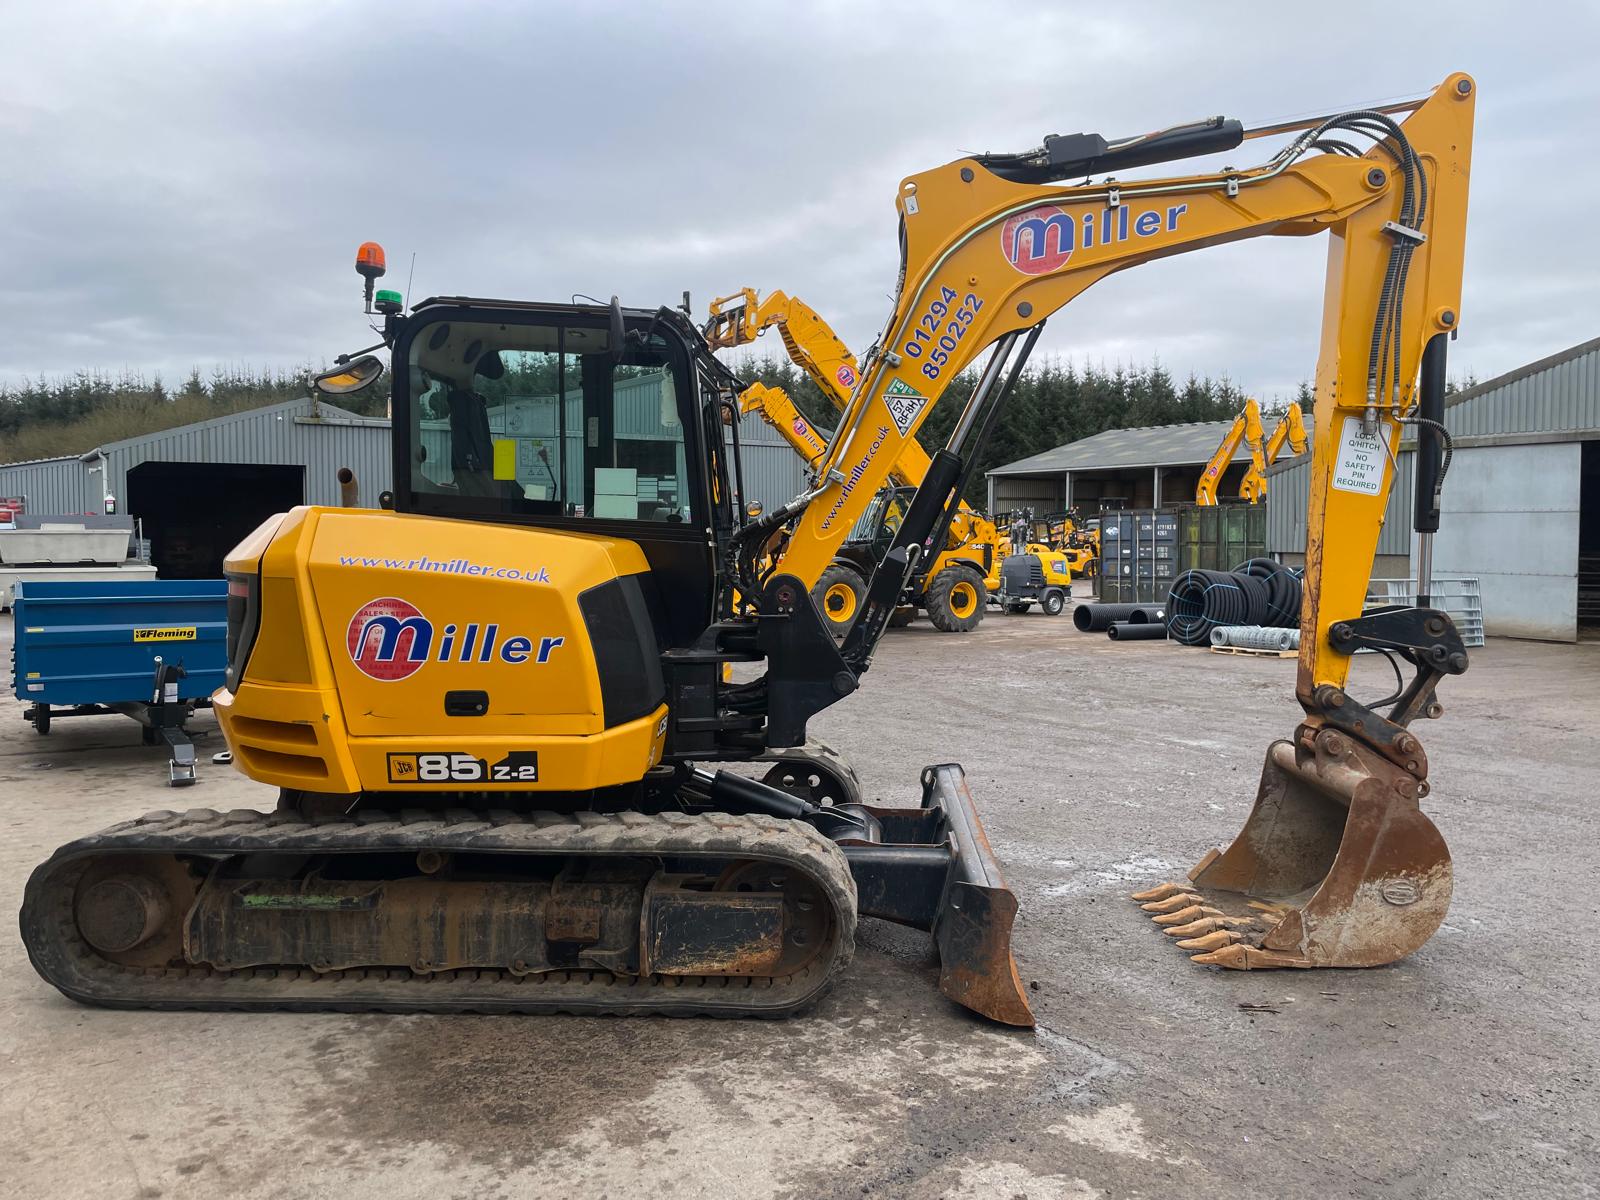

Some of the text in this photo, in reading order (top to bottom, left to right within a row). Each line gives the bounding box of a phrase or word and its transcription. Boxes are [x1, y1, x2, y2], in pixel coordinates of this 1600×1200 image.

[904, 284, 958, 359] 01294
[921, 293, 984, 380] 850252
[893, 400, 904, 413] 57
[898, 400, 918, 425] BF8H
[1354, 432, 1376, 441] LOCK
[1348, 440, 1380, 451] Q/HITCH
[1355, 454, 1368, 462] NO
[1344, 461, 1376, 472] SAFETY
[821, 426, 890, 529] www.rlmiller.co.uk
[1351, 471, 1366, 479] PIN
[1336, 477, 1377, 490] REQUIRED
[339, 556, 550, 583] www.rlmiller.co.uk
[146, 628, 195, 639] Fleming
[395, 754, 536, 781] JCB 85 Z-2
